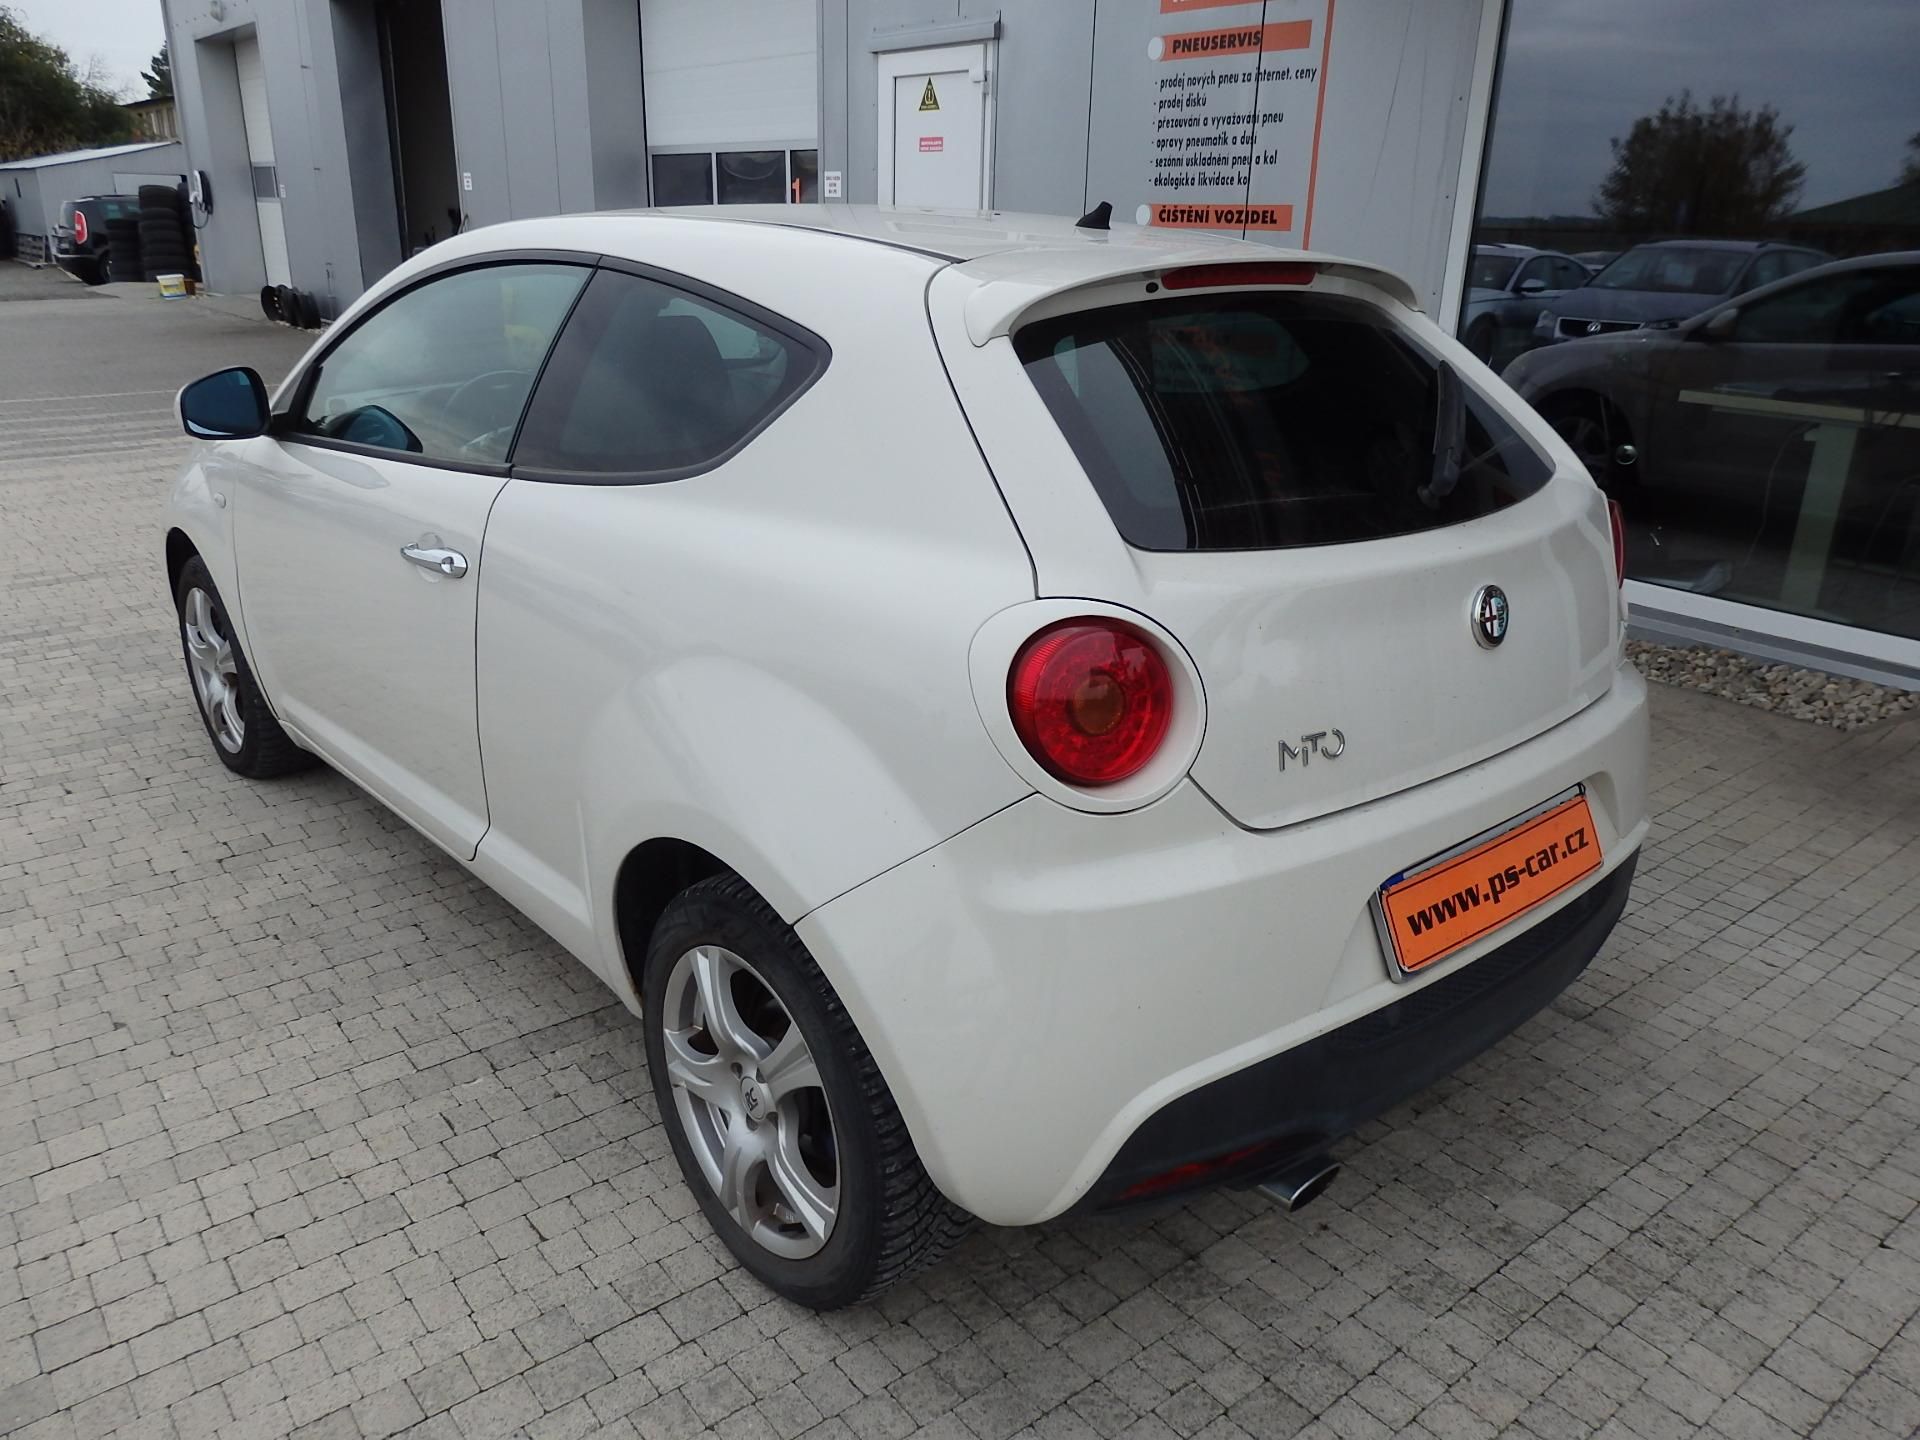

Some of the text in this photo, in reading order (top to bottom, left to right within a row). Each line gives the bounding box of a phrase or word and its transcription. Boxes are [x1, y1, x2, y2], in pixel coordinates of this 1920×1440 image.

[1172, 31, 1262, 54] PNEUSERVIS
[1160, 72, 1185, 92] prodej
[1187, 69, 1216, 90] nových
[1218, 72, 1239, 88] pneu
[1242, 72, 1252, 83] za
[1295, 67, 1318, 83] ceny
[1158, 93, 1184, 113] prodej
[1203, 117, 1209, 127] a
[1262, 112, 1284, 128] pneu
[1156, 138, 1184, 152] opravy
[1186, 131, 1229, 151] pneumatik
[1232, 136, 1238, 145] a
[1155, 154, 1184, 168] sezónní
[1255, 155, 1261, 166] a
[1263, 149, 1278, 165] kol
[1154, 171, 1196, 190] ekologická
[1198, 171, 1235, 186] likvidace
[1158, 205, 1278, 225] ČIŠTĚNÍ VOZIDEL
[1406, 827, 1590, 937] www.ps-car.cz
